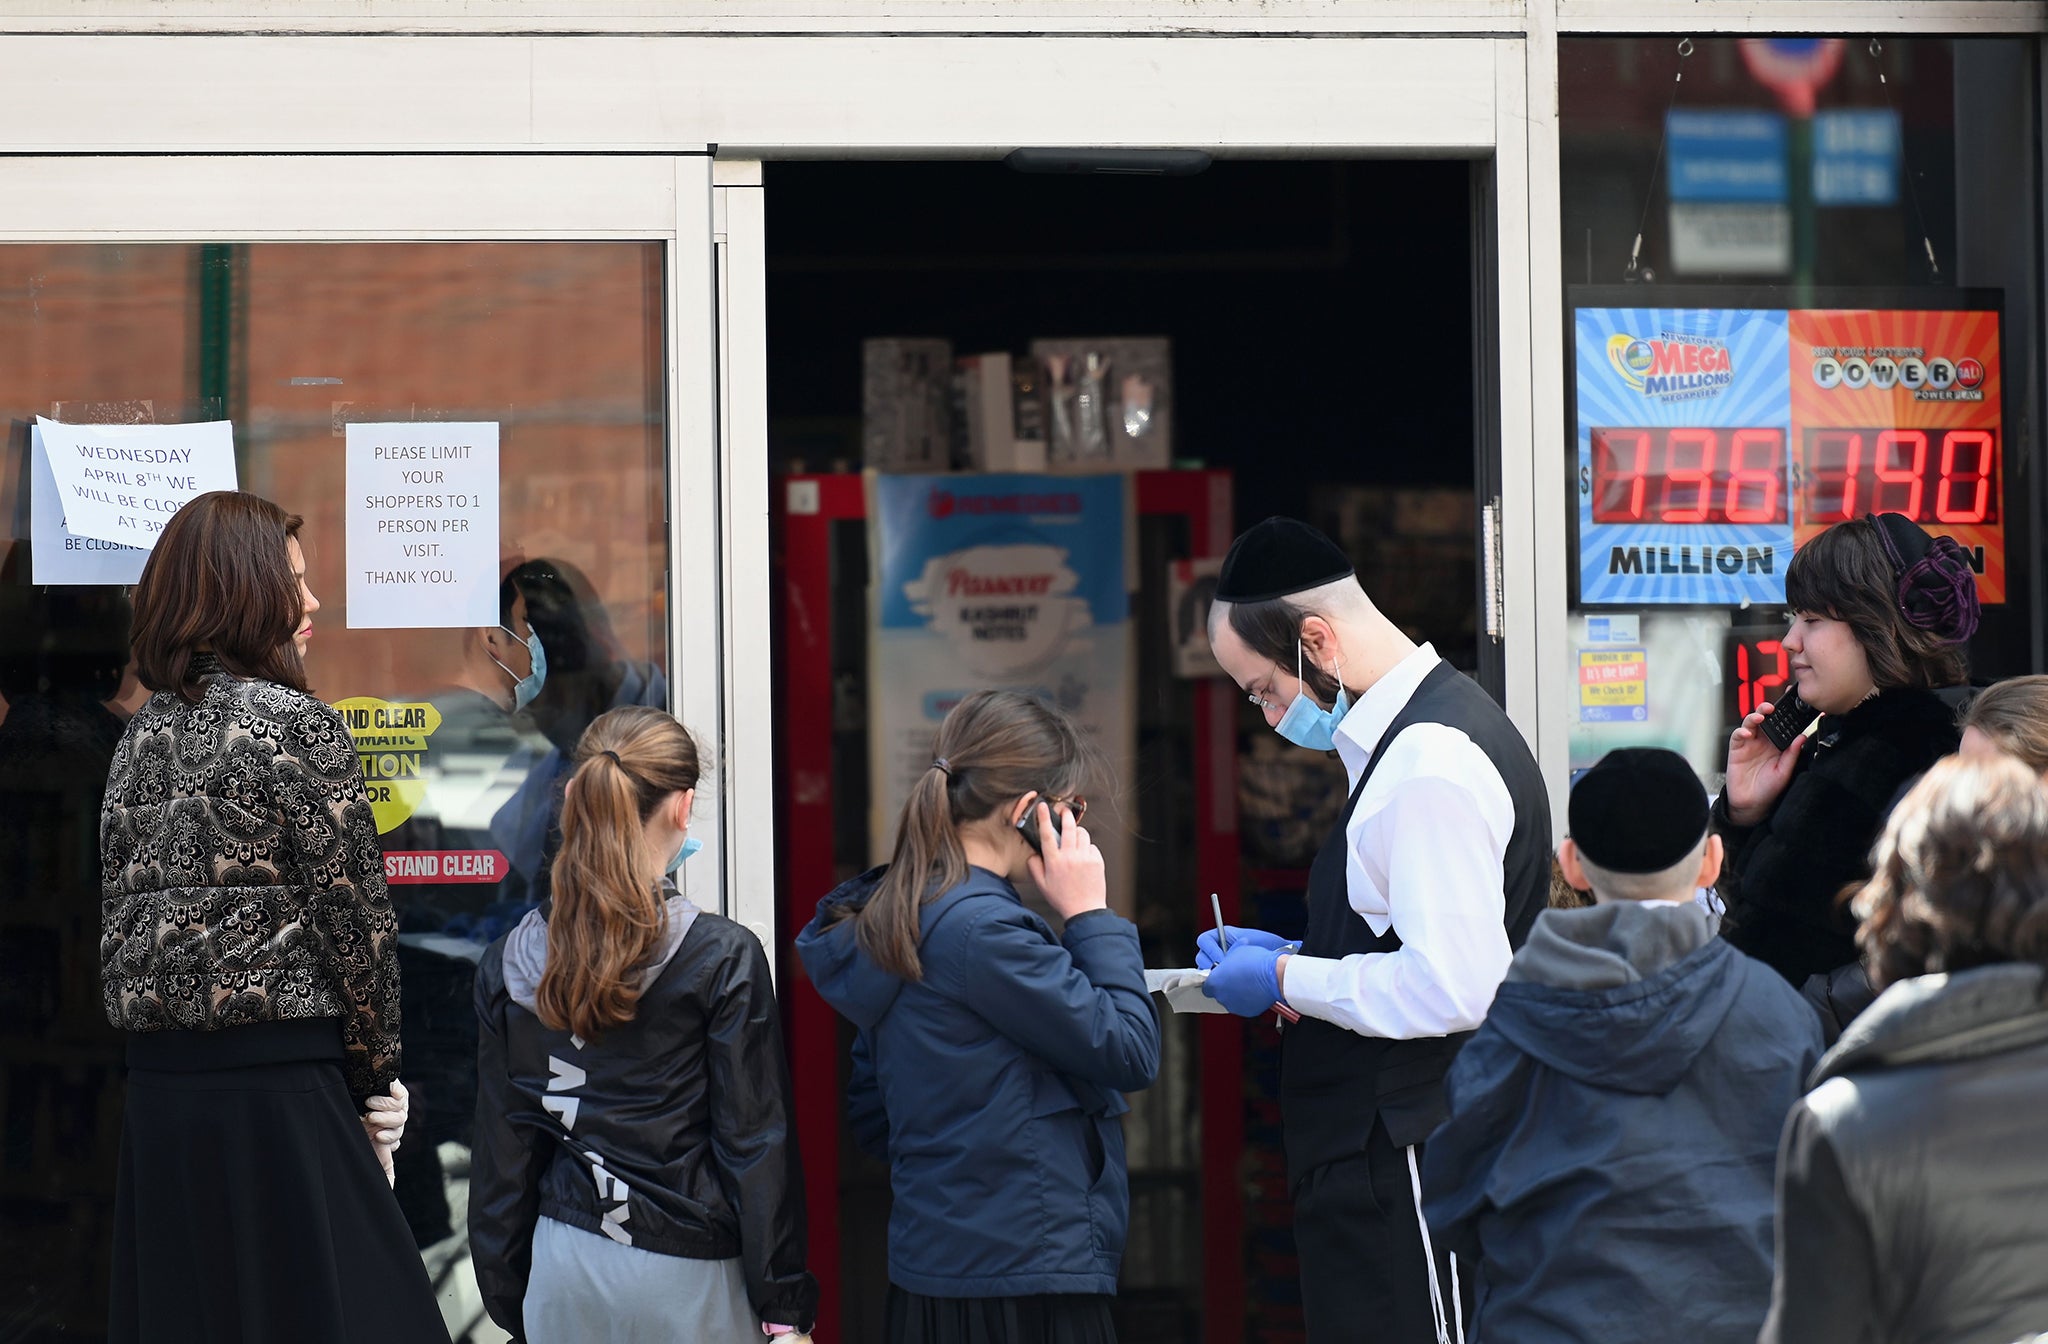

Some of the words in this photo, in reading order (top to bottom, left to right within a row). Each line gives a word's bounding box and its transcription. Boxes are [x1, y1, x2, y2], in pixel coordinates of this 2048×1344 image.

[1648, 340, 1731, 375] MEGA
[1645, 373, 1731, 395] MILLIONS
[76, 444, 192, 464] WEDNESDAY
[374, 446, 427, 460] PLEASE
[431, 445, 472, 459] LIMIT
[84, 467, 132, 486] APRIL
[166, 476, 198, 490] WE
[401, 470, 444, 484] YOUR
[1579, 466, 1590, 498] $
[1631, 428, 1781, 523] 136
[1841, 430, 1993, 522] 190
[73, 484, 115, 504] WILL
[117, 494, 139, 509] BE
[144, 498, 186, 513] CLOS
[365, 495, 443, 509] SHOPPERS
[447, 494, 467, 508] TO
[472, 494, 480, 508] 1
[118, 515, 136, 529] AT
[143, 519, 168, 533] 3P
[378, 519, 437, 533] PERSON
[442, 519, 469, 532] PER
[65, 538, 81, 550] BE
[403, 543, 444, 557] VISIT.
[1609, 545, 1774, 575] MILLION
[365, 571, 416, 584] THANK
[420, 570, 457, 583] YOU.
[374, 708, 426, 729] CLEAR
[386, 856, 439, 877] STAND
[443, 855, 495, 876] CLEAR
